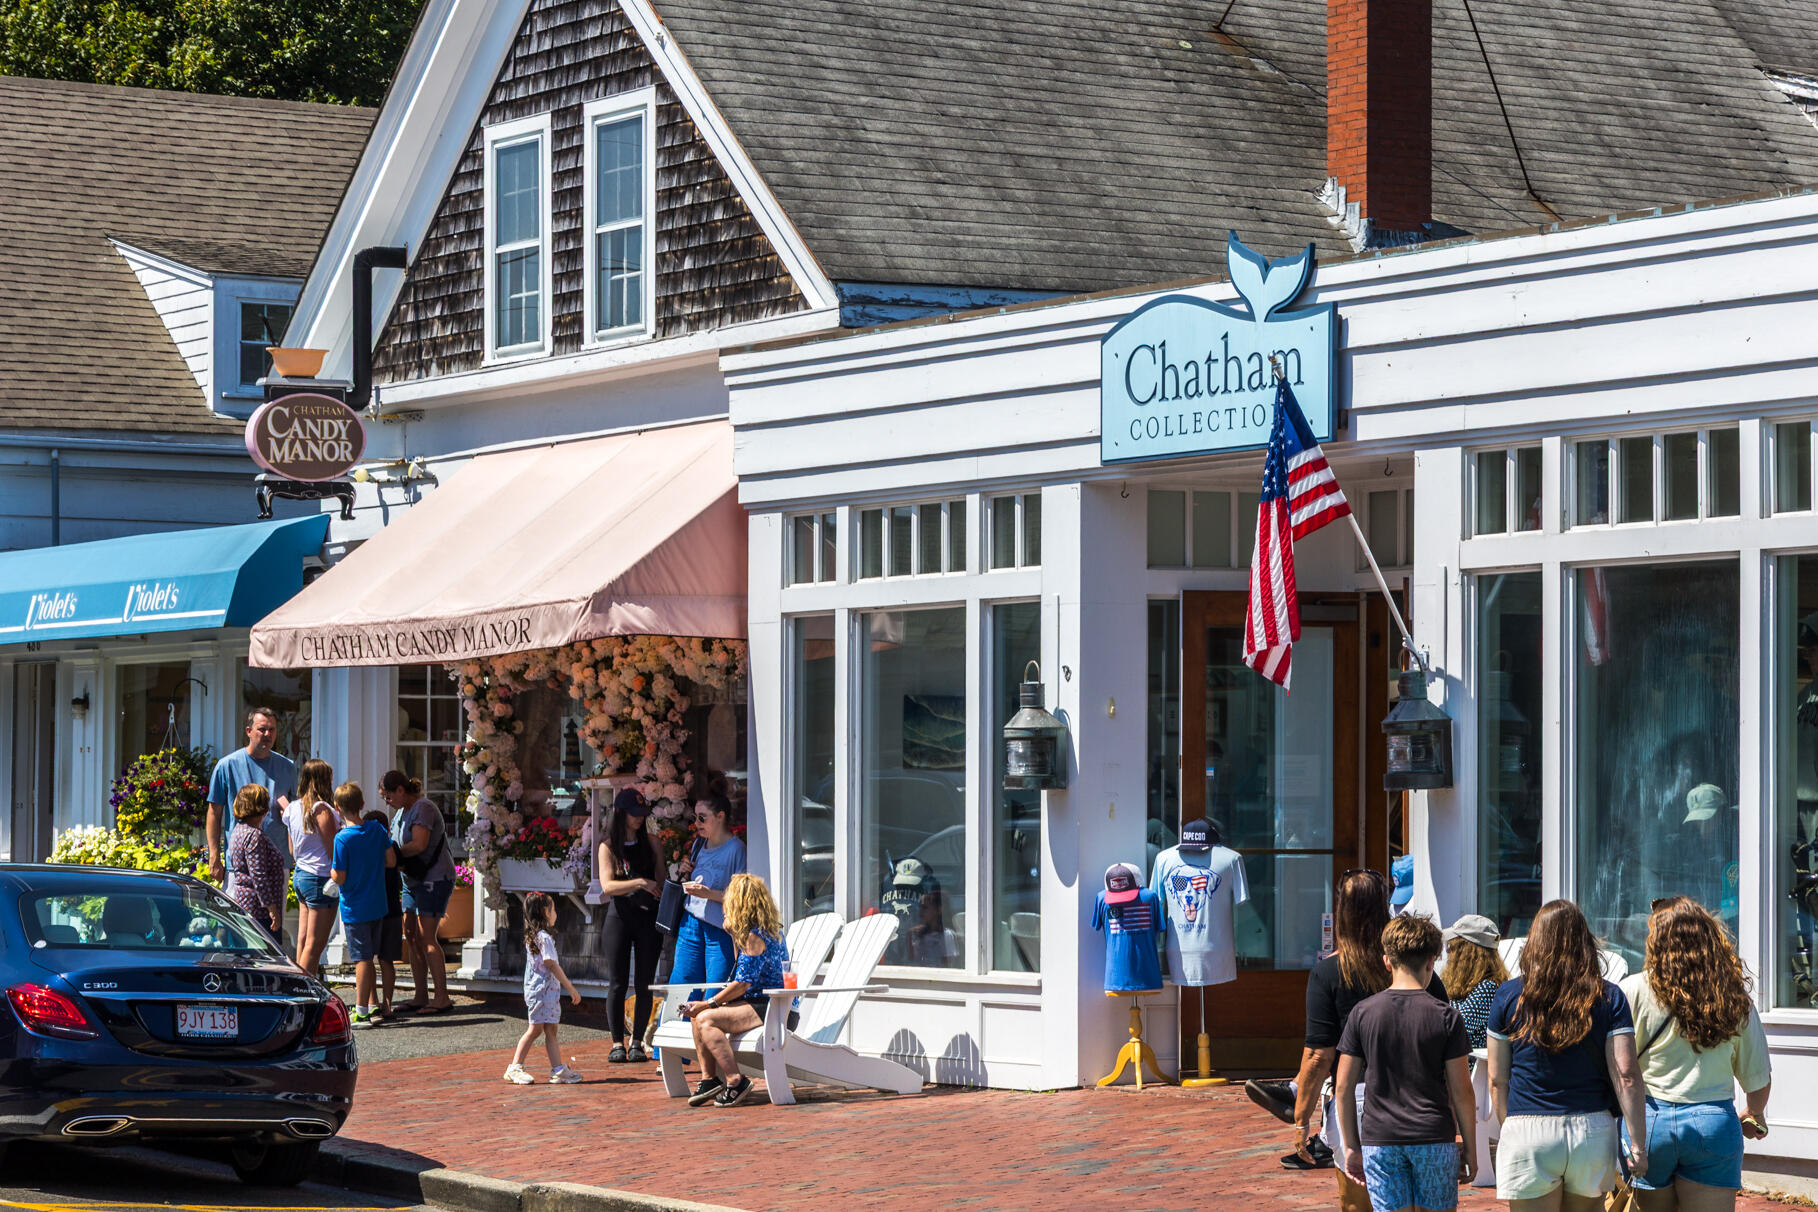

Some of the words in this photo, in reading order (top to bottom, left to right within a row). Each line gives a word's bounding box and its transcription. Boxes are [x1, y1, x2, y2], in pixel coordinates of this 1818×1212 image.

[1125, 331, 1304, 406] Chatham
[267, 406, 352, 440] CANDY
[293, 405, 345, 416] CHATHAM
[1130, 403, 1274, 441] COLLECTIO
[268, 437, 354, 463] MANOR
[25, 592, 78, 630] Violet's
[123, 582, 179, 623] Violet's
[301, 633, 391, 661] CHATHAM
[395, 627, 457, 657] CANDY
[461, 617, 532, 652] MANOR
[1183, 832, 1194, 840] CAPE
[1195, 832, 1206, 841] COD
[179, 1011, 205, 1029] 9JY
[210, 1012, 237, 1030] 138
